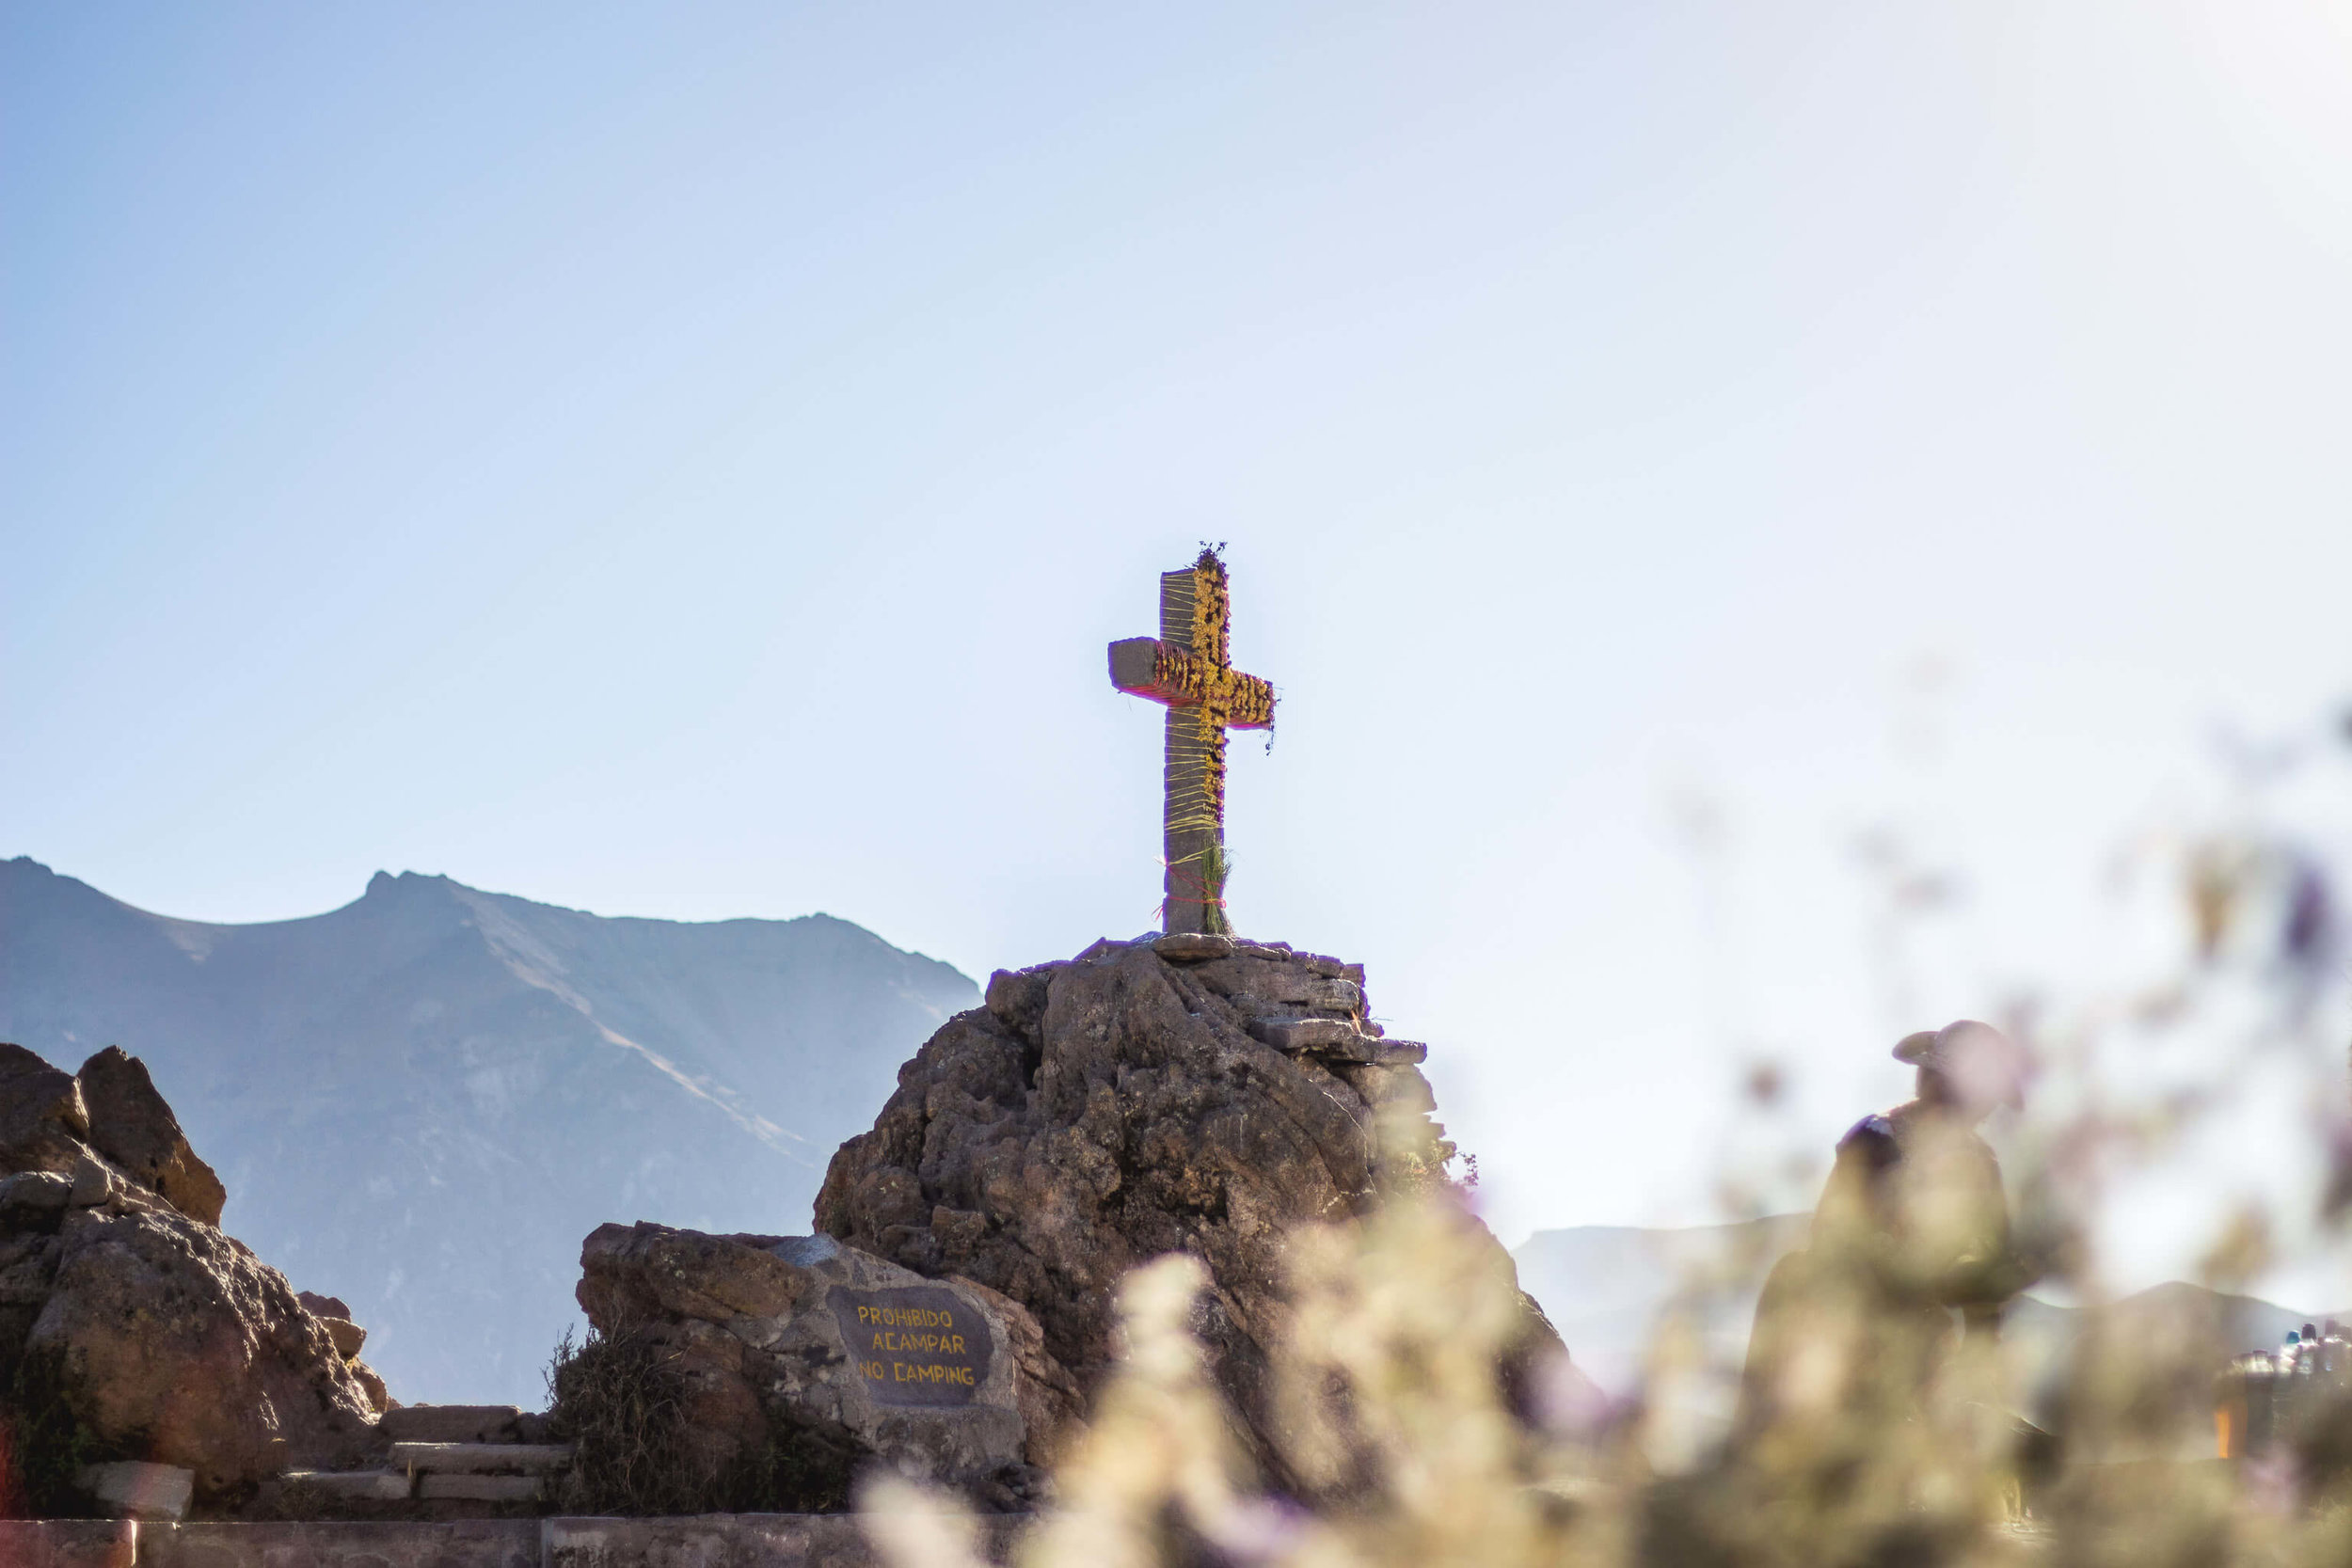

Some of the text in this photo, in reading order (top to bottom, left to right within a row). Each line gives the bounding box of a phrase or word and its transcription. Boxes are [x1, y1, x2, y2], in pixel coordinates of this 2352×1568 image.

[858, 1306, 953, 1328] PROHIBIDO
[872, 1332, 966, 1354] ACAMPAR
[859, 1361, 976, 1386] NO CAMPING
